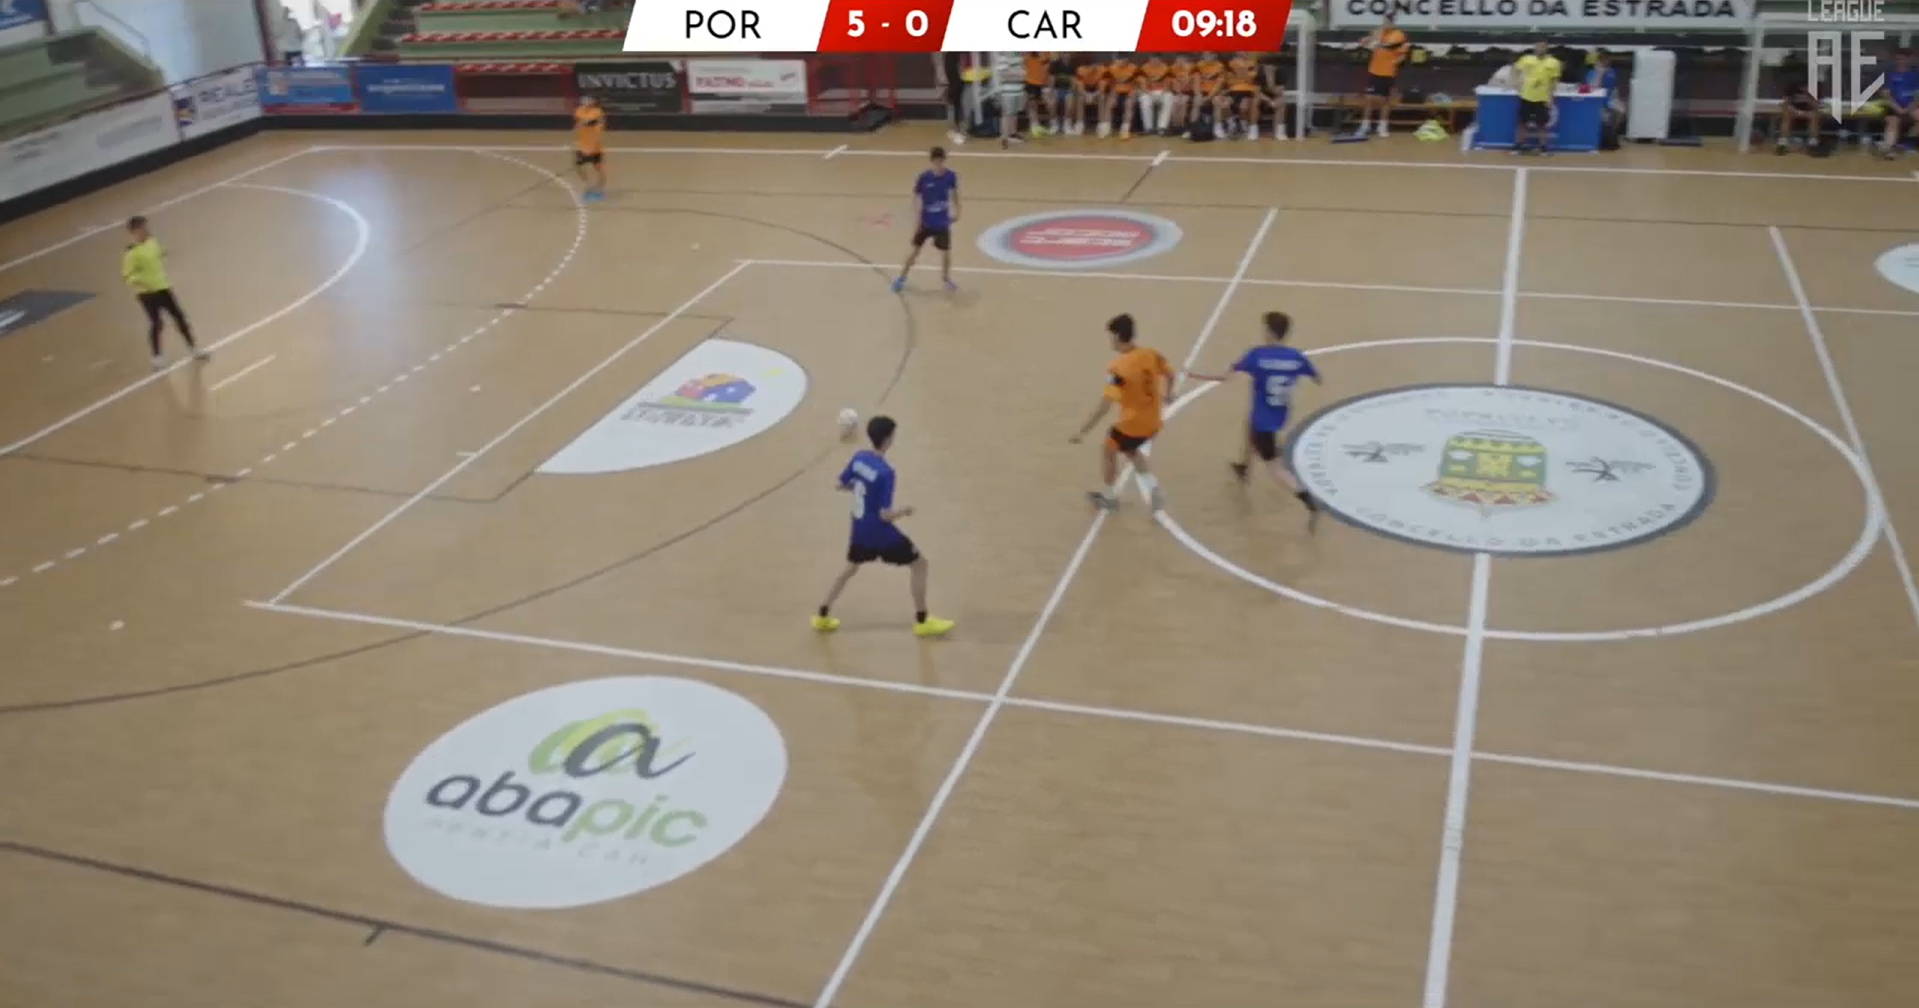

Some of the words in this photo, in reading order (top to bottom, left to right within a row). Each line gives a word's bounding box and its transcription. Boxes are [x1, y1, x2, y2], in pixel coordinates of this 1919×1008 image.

[1347, 0, 1516, 16] CONCELLO
[1528, 0, 1568, 17] DA
[1582, 0, 1736, 18] ESTRADA
[578, 72, 676, 89] INVICTUS
[425, 770, 708, 848] abapic
